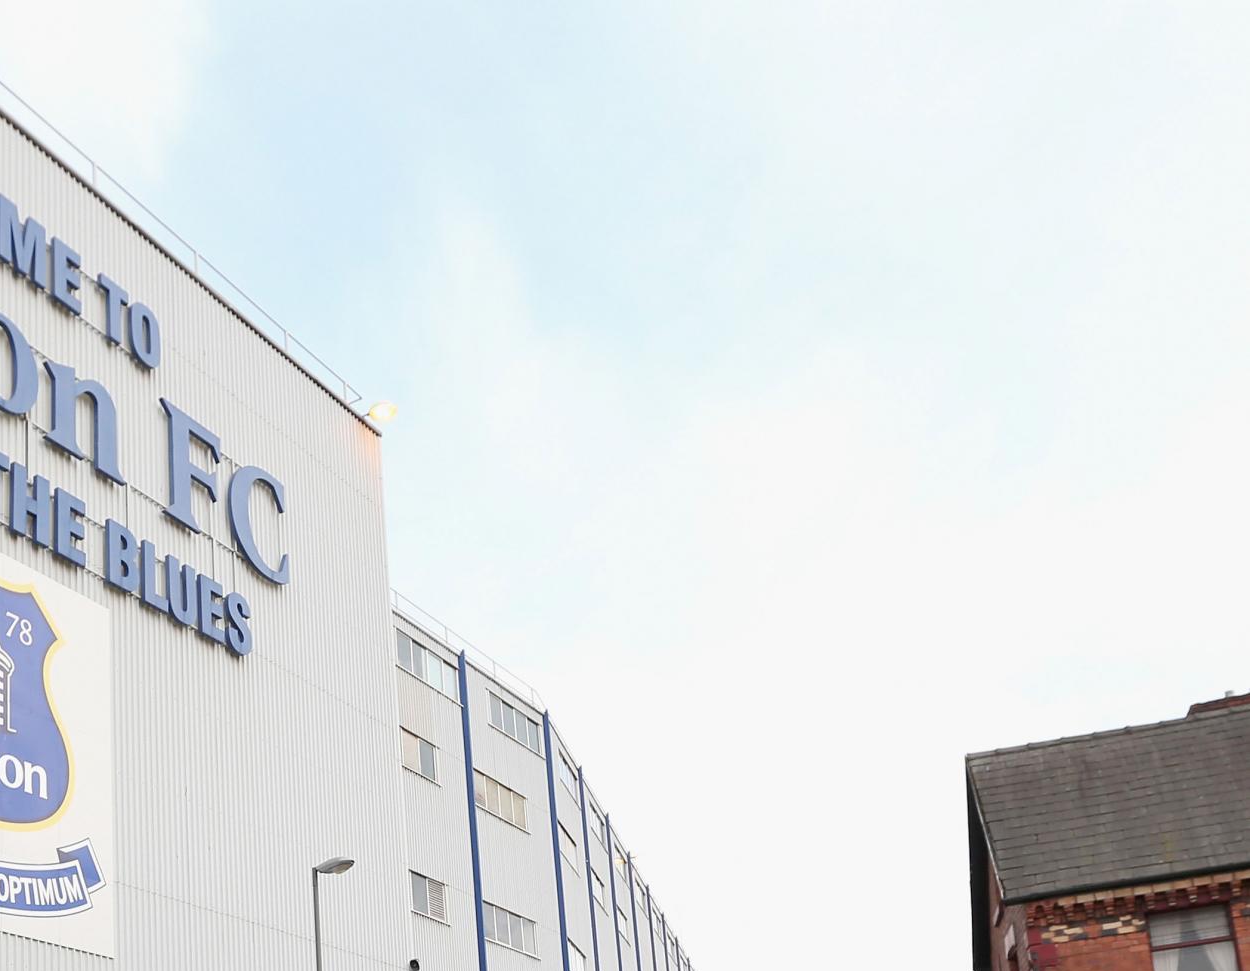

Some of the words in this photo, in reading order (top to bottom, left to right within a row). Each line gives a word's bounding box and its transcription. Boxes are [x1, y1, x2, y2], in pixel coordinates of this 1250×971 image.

[97, 273, 160, 370] TO
[159, 397, 290, 586] FC
[4, 612, 34, 647] 78
[104, 518, 254, 657] BLUES
